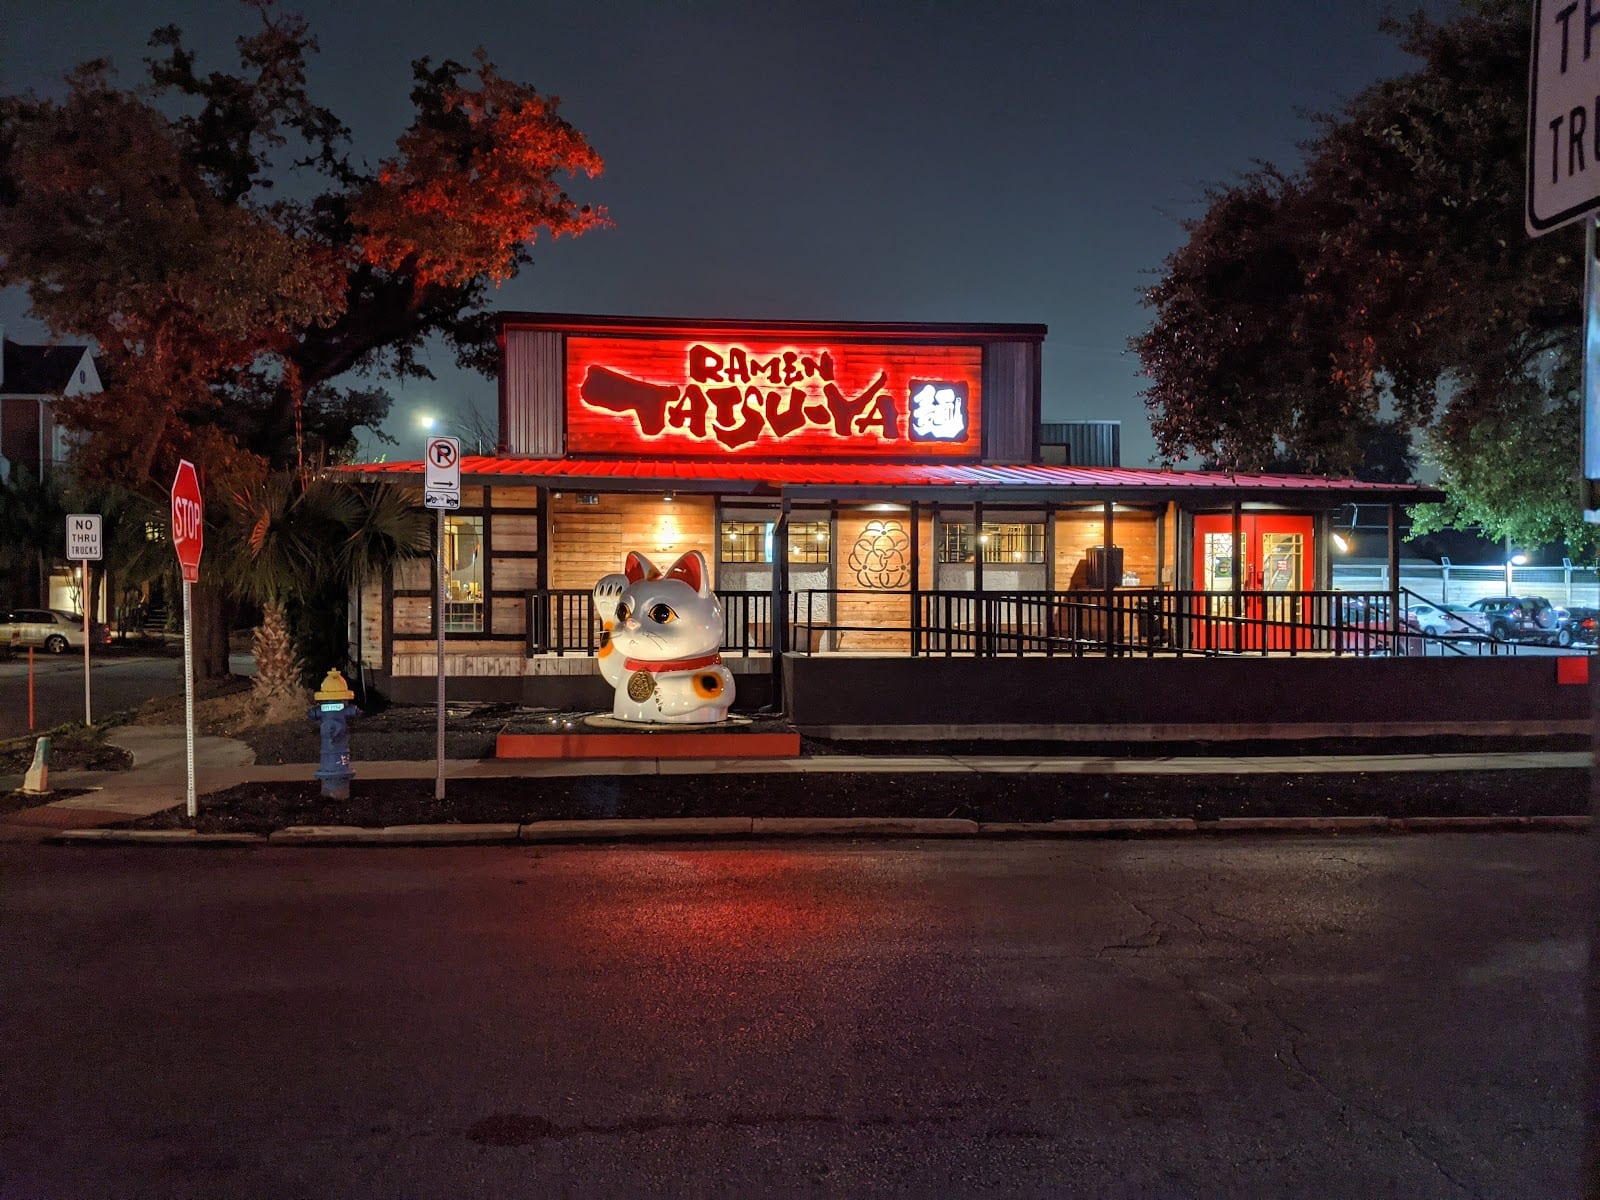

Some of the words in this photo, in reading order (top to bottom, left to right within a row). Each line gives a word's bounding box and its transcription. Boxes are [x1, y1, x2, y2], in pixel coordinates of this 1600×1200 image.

[689, 344, 833, 386] RAMEN
[581, 364, 899, 449] TATSU-YA
[75, 520, 93, 530] NO
[175, 496, 200, 540] STOP
[72, 533, 97, 542] THRU
[72, 546, 98, 555] TRUCKS
